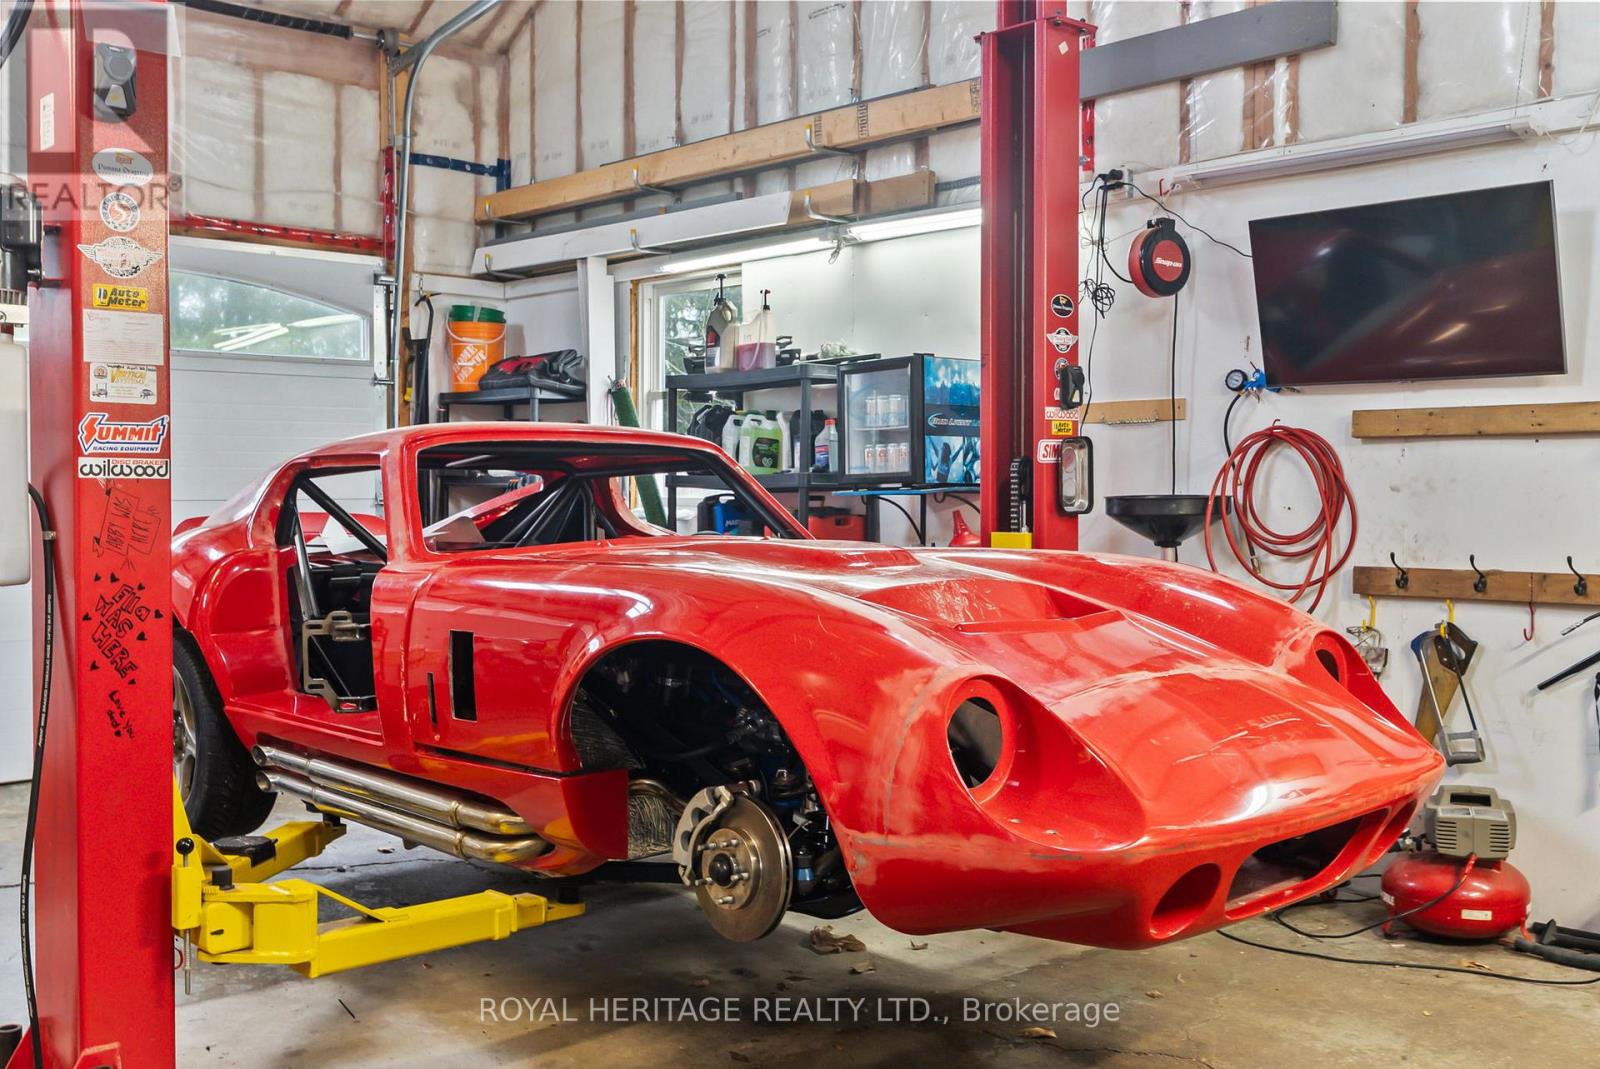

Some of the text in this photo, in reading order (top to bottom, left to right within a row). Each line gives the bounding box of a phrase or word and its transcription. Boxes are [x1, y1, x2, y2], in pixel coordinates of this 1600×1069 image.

[108, 297, 146, 307] Meter
[110, 288, 140, 298] Auto
[80, 459, 168, 477] wilwood
[95, 594, 134, 638] WAS
[92, 620, 139, 679] HERE
